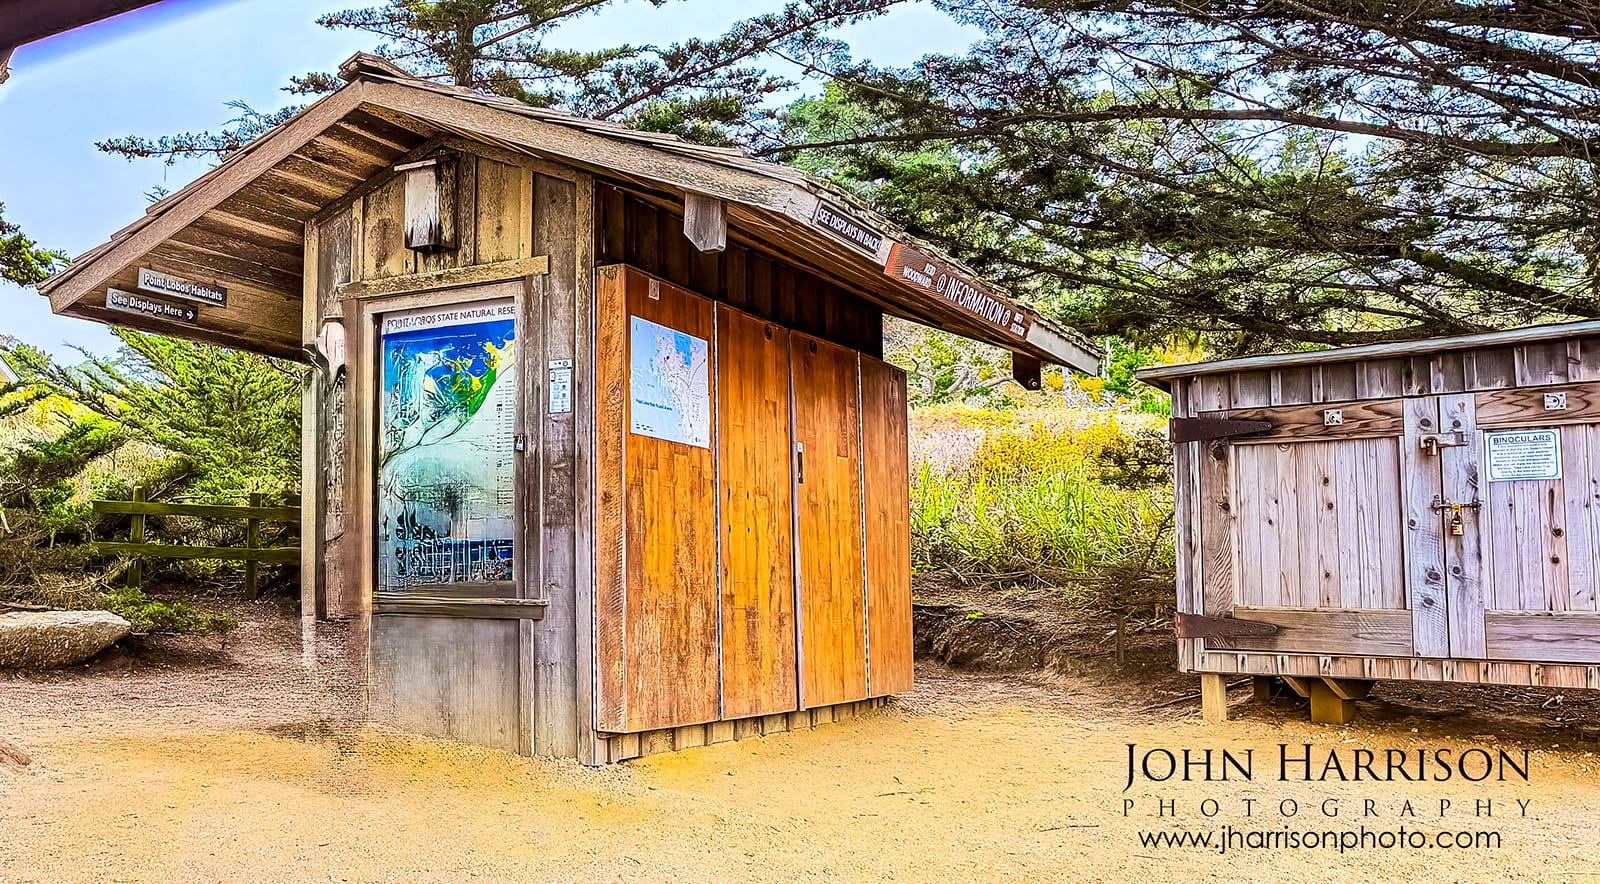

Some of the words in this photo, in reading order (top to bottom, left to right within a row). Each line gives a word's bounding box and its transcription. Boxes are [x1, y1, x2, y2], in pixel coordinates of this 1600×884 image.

[818, 209, 832, 225] SEE
[829, 215, 859, 239] DISPLAYS
[144, 273, 165, 288] Point
[167, 278, 189, 294] Lobos
[191, 285, 223, 302] Habitats
[112, 292, 128, 306] See
[129, 297, 162, 314] Displays
[164, 304, 183, 317] Here
[437, 311, 459, 322] STATE
[460, 307, 496, 320] NATURAL
[943, 278, 1006, 326] INFORMATION
[1492, 435, 1552, 444] BINOCULARS
